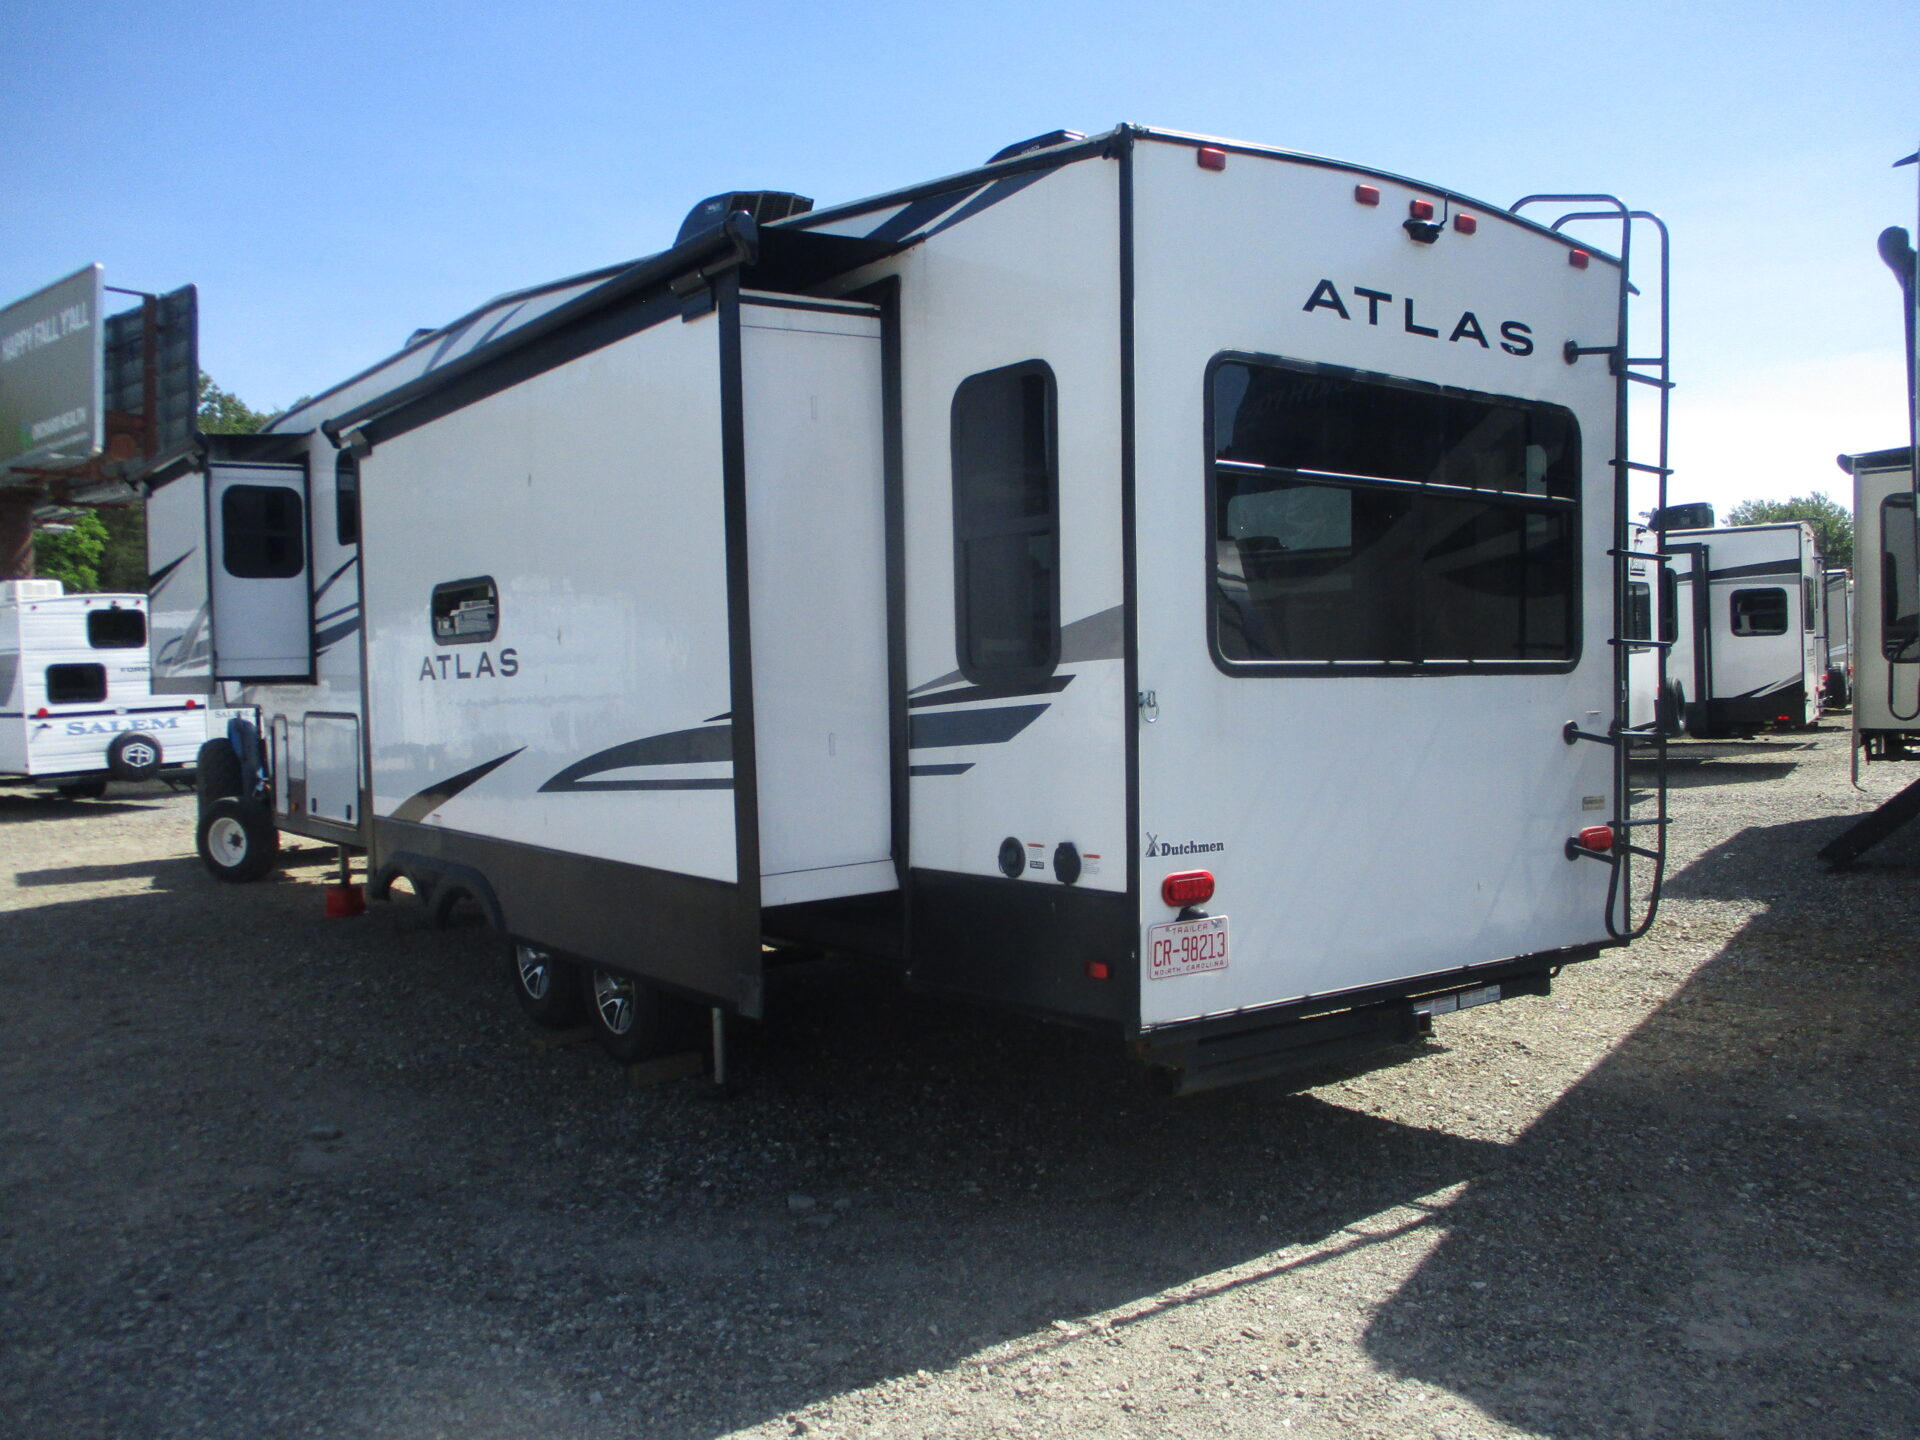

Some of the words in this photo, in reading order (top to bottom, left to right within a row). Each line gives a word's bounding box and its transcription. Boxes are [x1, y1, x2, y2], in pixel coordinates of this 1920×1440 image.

[1302, 278, 1534, 357] ATLAS
[419, 647, 519, 681] ATLAS
[65, 717, 179, 735] SALEM
[1161, 841, 1225, 856] Dutchmen
[1172, 923, 1209, 935] TRAILER
[1153, 931, 1225, 967] CR-98213
[1154, 967, 1182, 976] NORTH
[1186, 960, 1224, 971] CAROLINA
